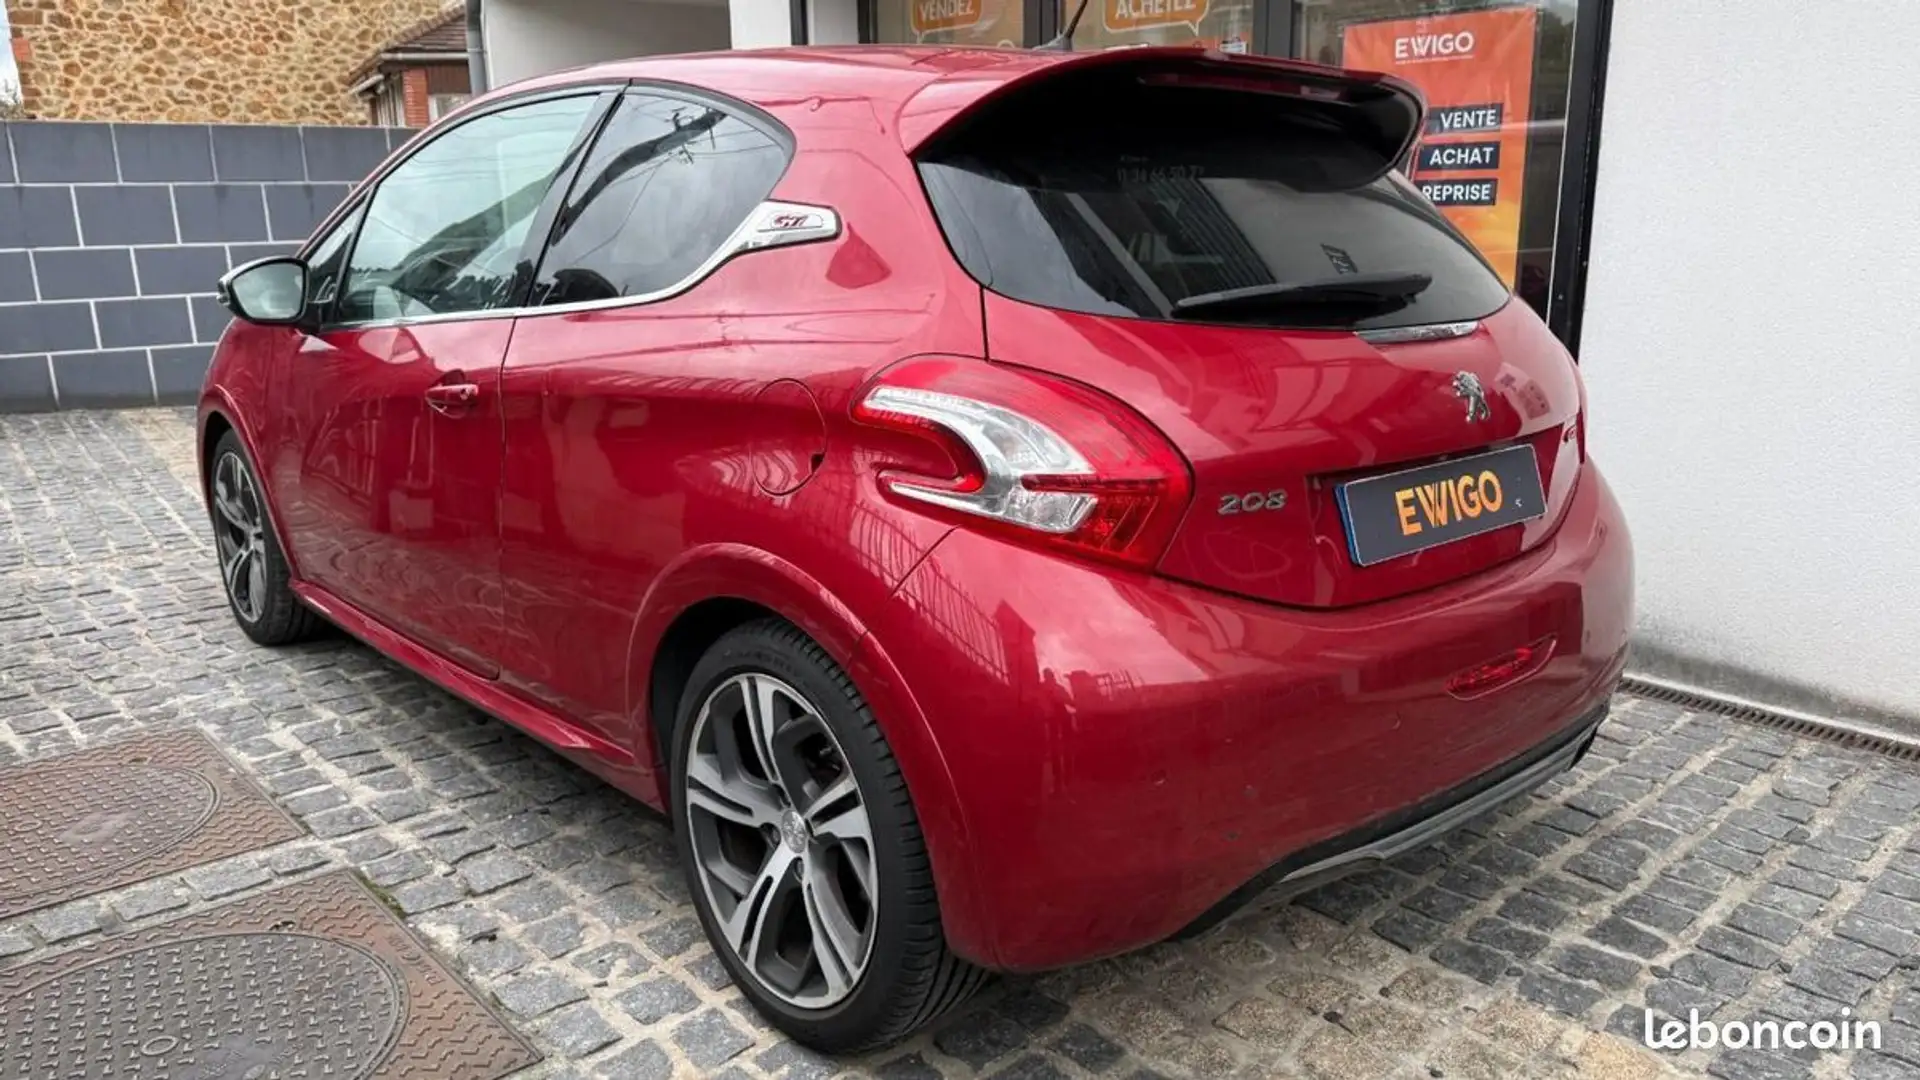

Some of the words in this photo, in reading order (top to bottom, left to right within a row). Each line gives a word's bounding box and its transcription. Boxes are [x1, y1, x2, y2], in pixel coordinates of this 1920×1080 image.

[1395, 31, 1475, 58] EWIGO
[1440, 109, 1497, 129] VENTE
[1429, 147, 1494, 166] ACHAT
[1422, 183, 1491, 201] REPRISE
[1217, 489, 1288, 515] 208
[1395, 469, 1502, 536] EWIGO
